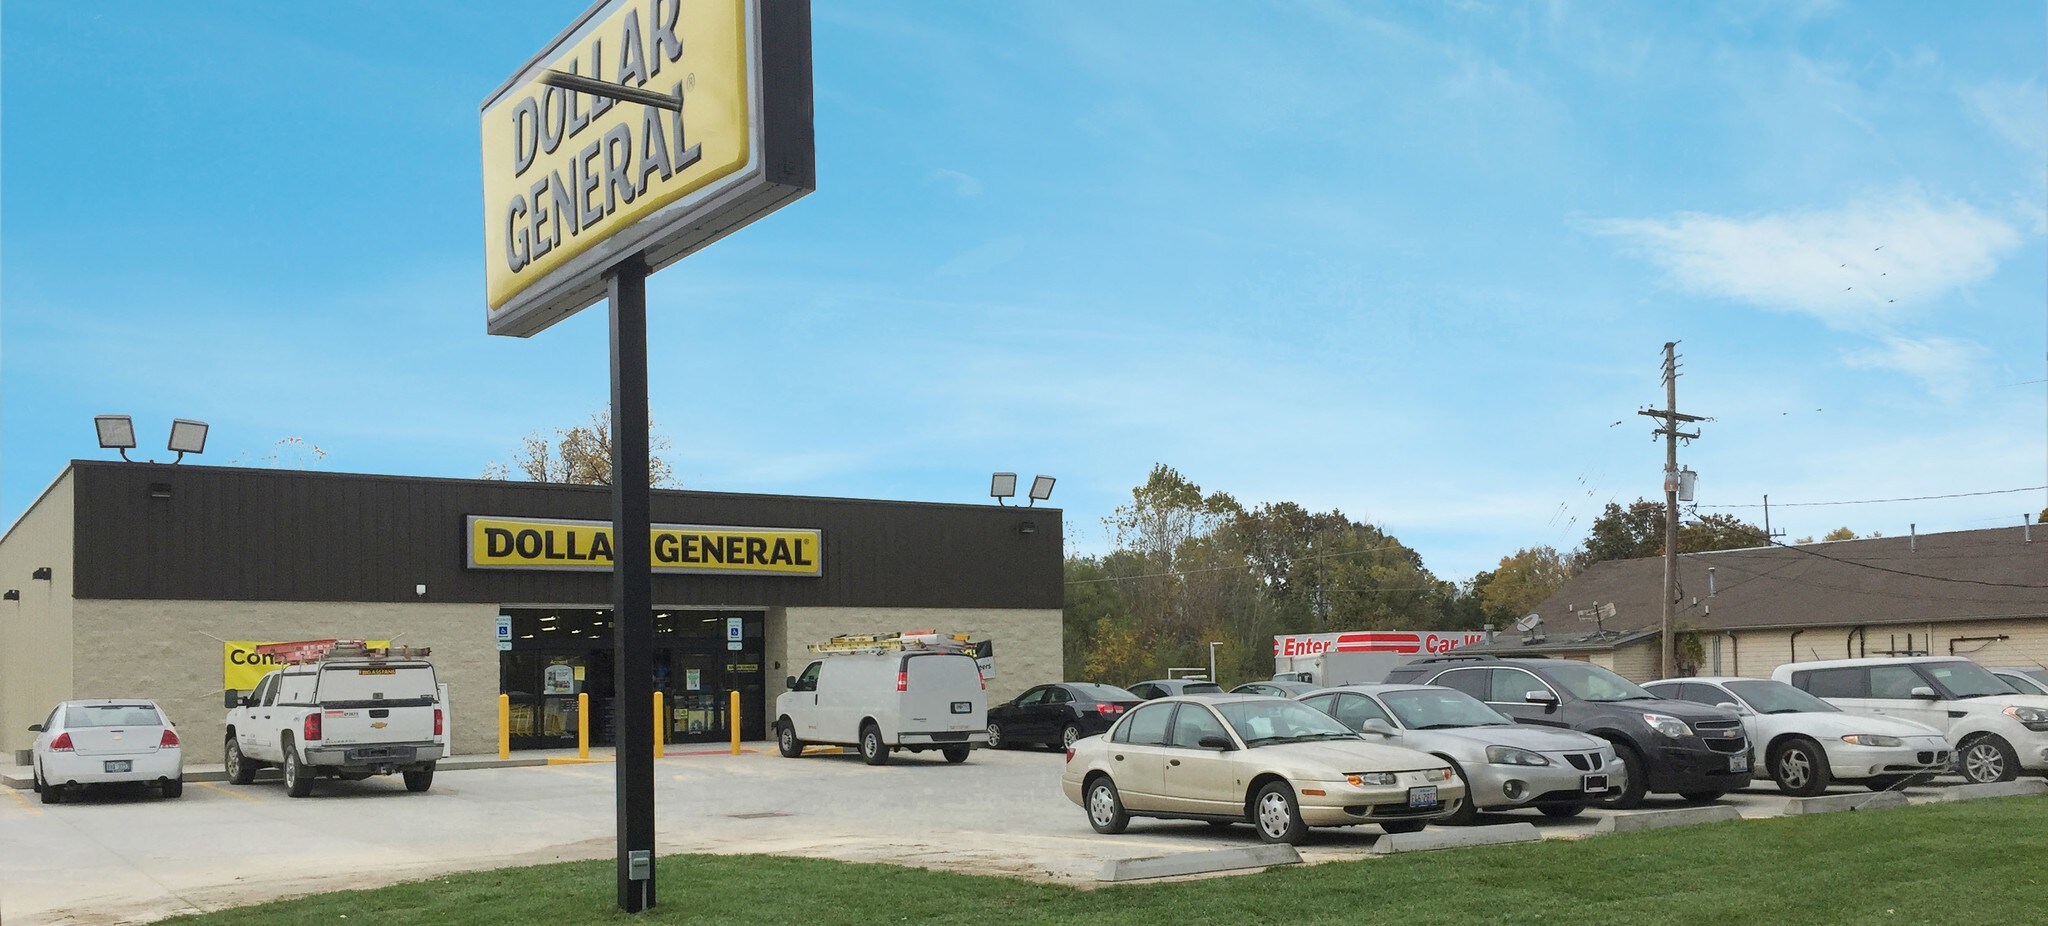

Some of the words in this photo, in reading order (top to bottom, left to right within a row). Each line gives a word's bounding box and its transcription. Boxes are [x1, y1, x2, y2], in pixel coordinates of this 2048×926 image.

[512, 0, 683, 178] DOLLAR
[505, 79, 702, 273] GENERAL
[485, 528, 614, 560] DOLLA
[654, 533, 812, 566] GENERAL
[1283, 638, 1331, 656] Enter
[1425, 634, 1459, 654] Car
[1464, 634, 1482, 646] W
